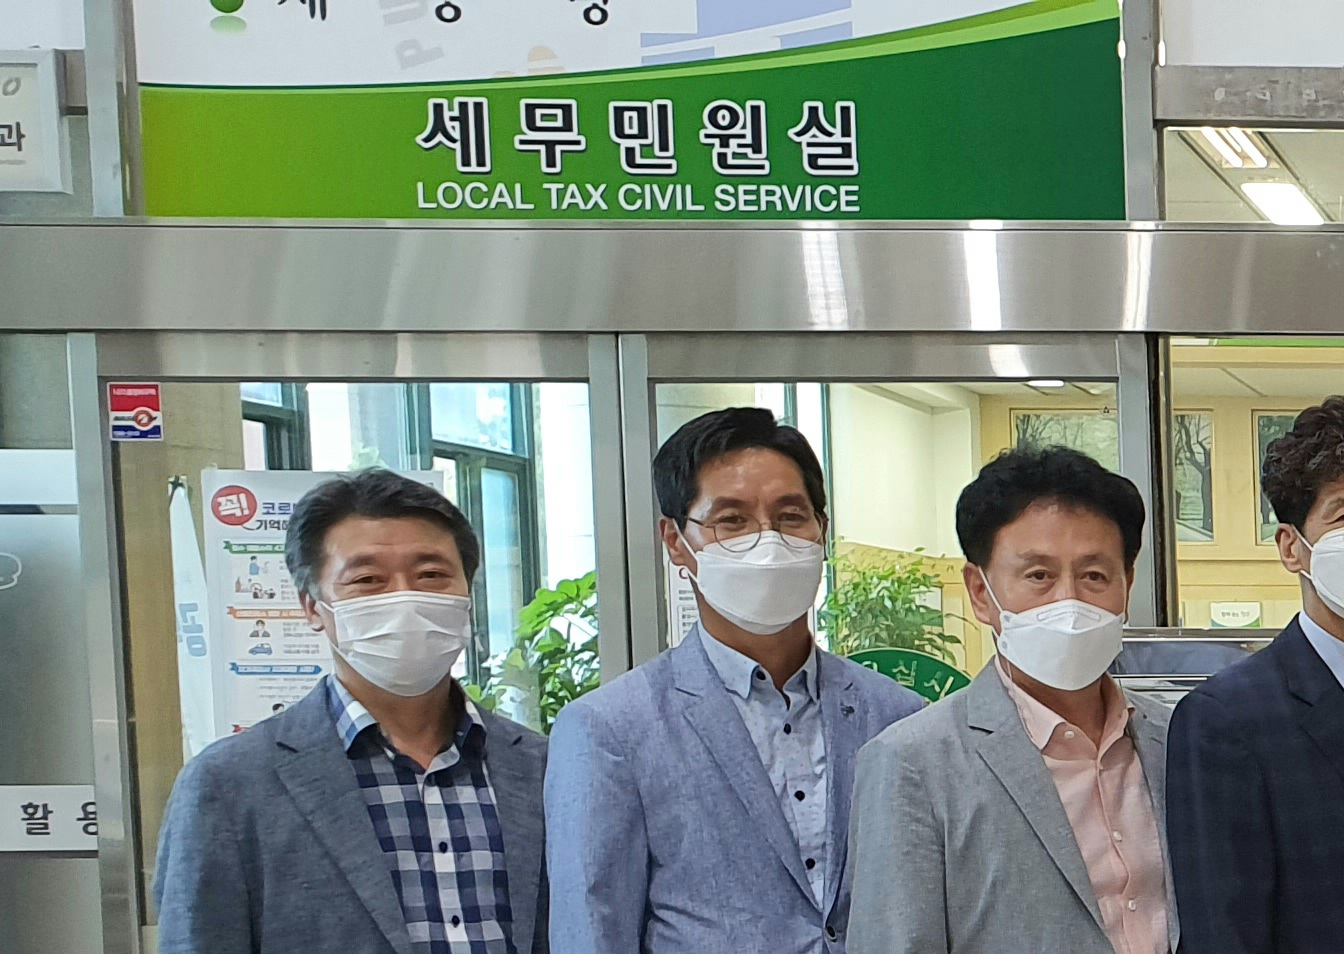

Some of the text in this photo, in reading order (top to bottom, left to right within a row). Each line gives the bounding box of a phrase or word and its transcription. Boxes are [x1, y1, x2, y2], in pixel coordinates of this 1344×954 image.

[415, 96, 860, 176] 세무민원실
[416, 182, 861, 213] LOCAL TAX CIVIL SERVICE
